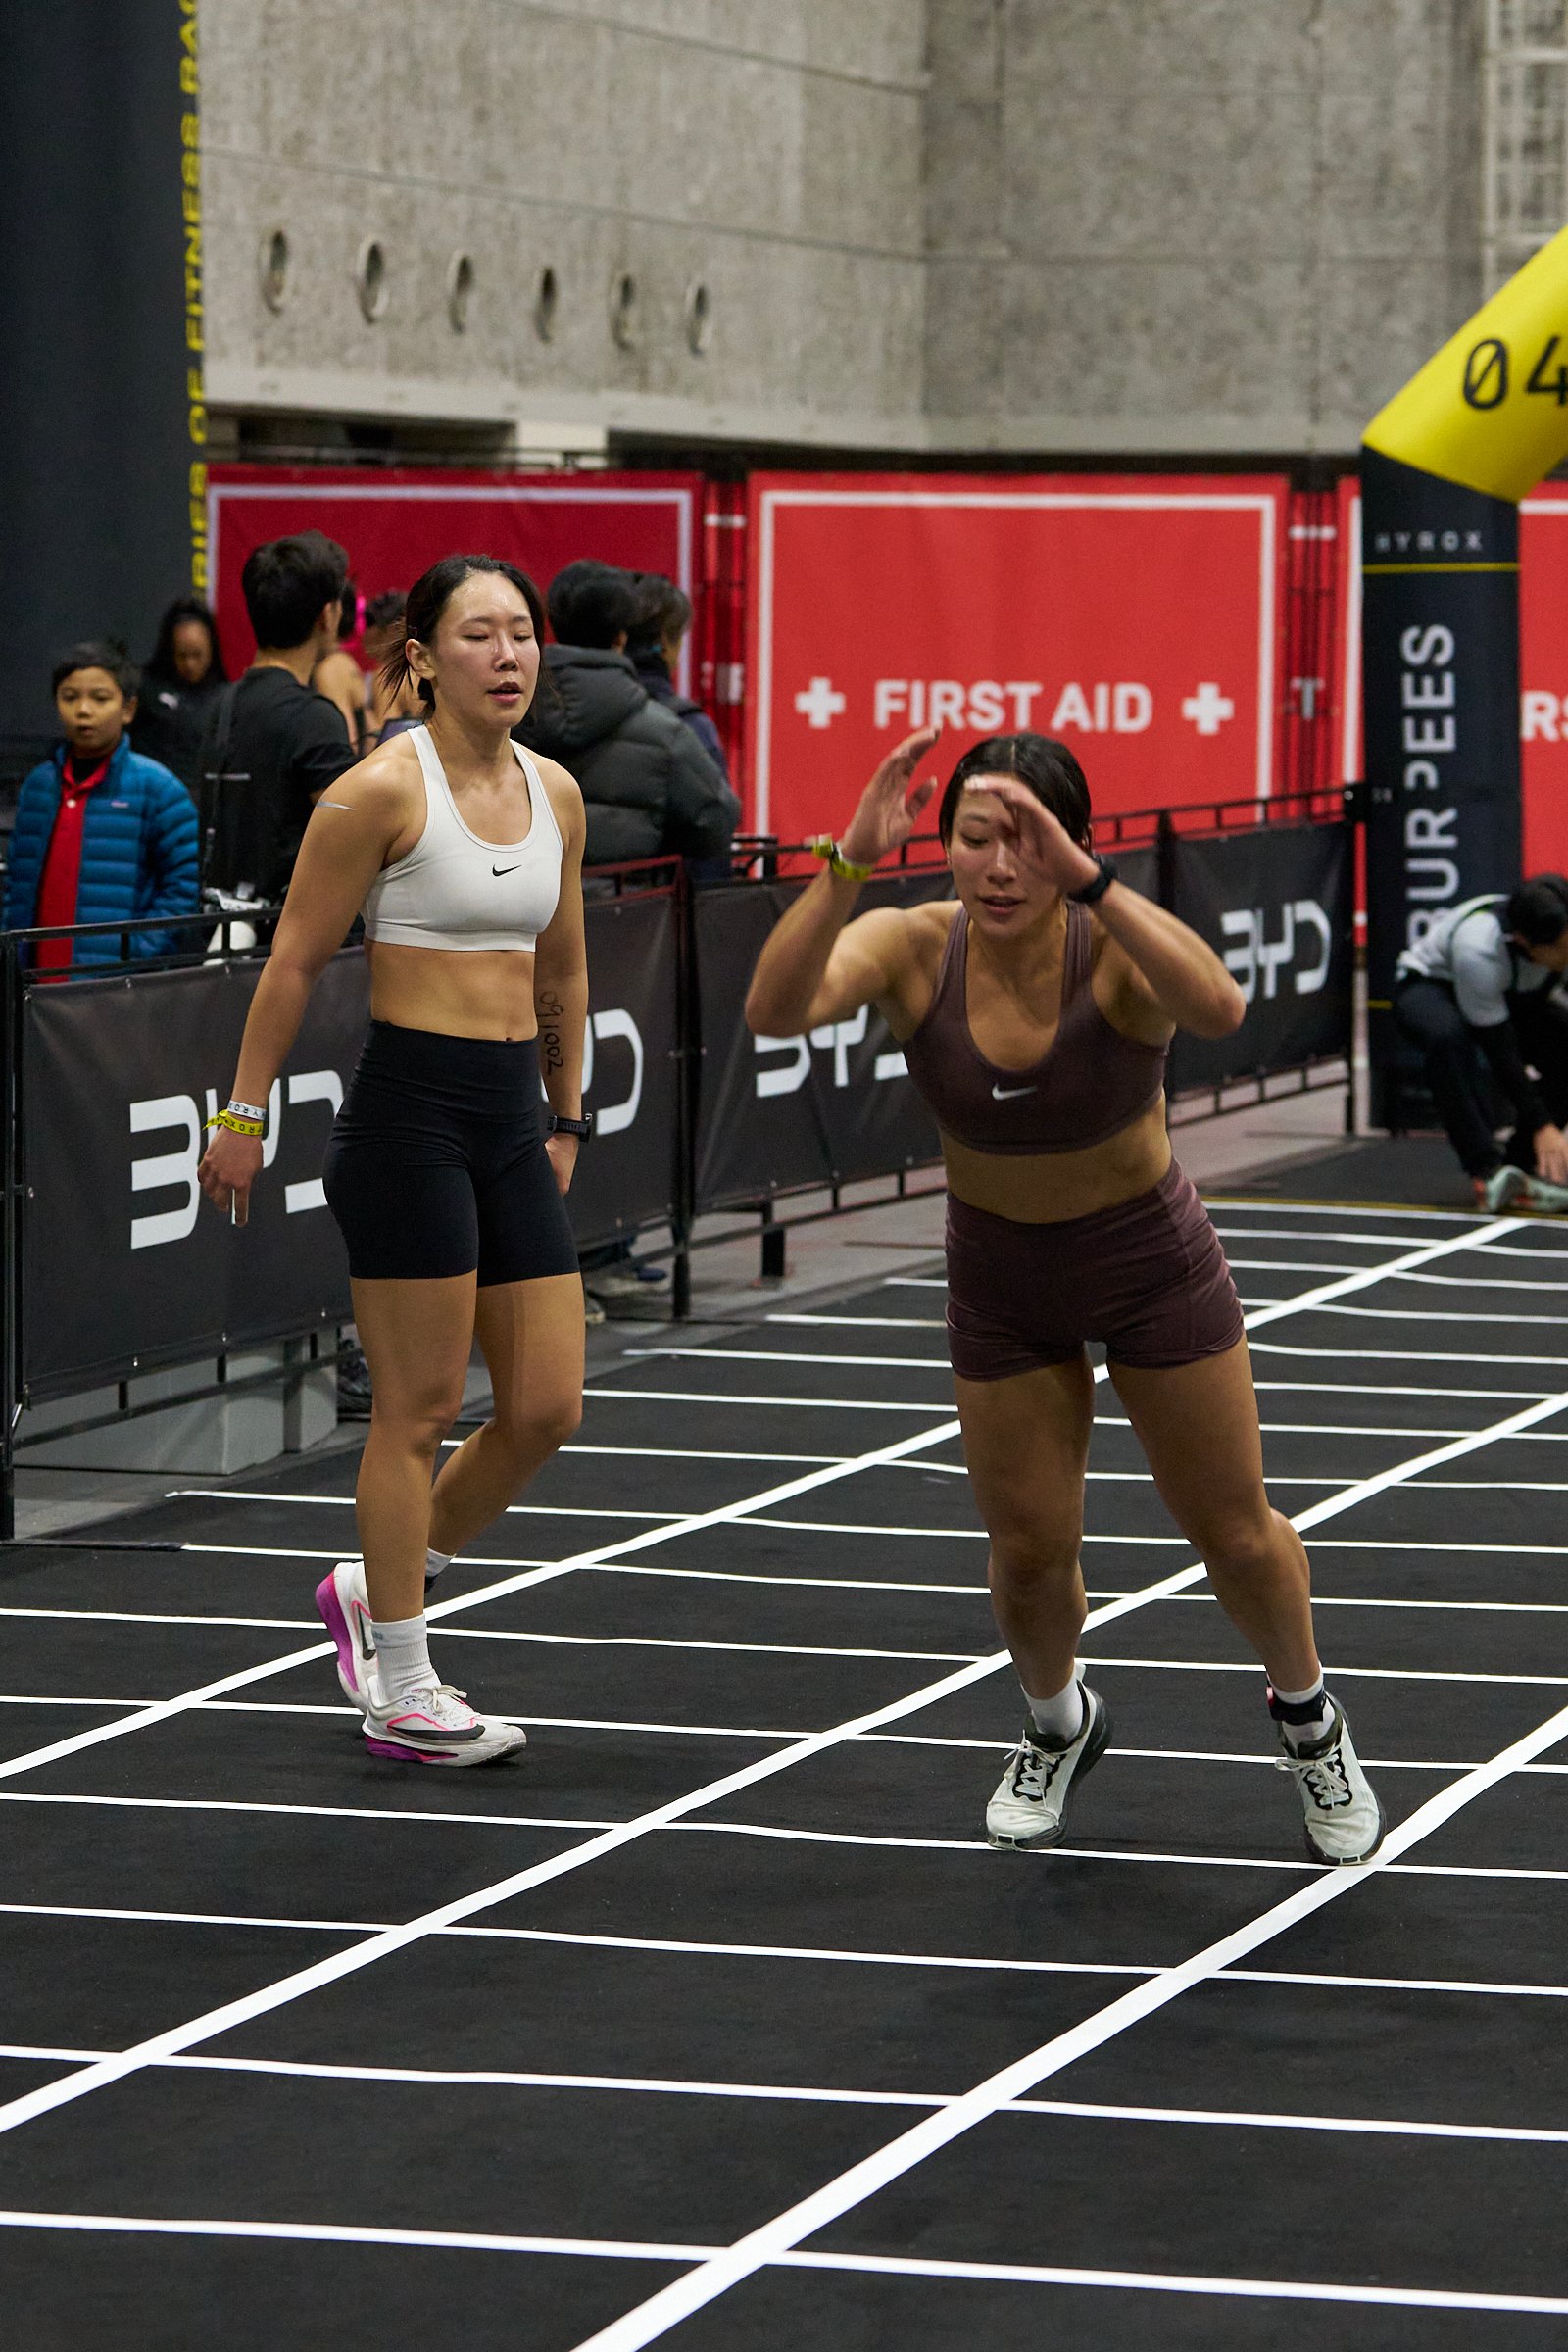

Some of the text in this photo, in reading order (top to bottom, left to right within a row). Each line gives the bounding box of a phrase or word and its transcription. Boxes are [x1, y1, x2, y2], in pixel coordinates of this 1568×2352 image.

[1463, 336, 1568, 411] 04
[1374, 530, 1483, 553] HYROX
[874, 679, 1153, 733] FIRST AID
[1220, 900, 1332, 1003] BYD
